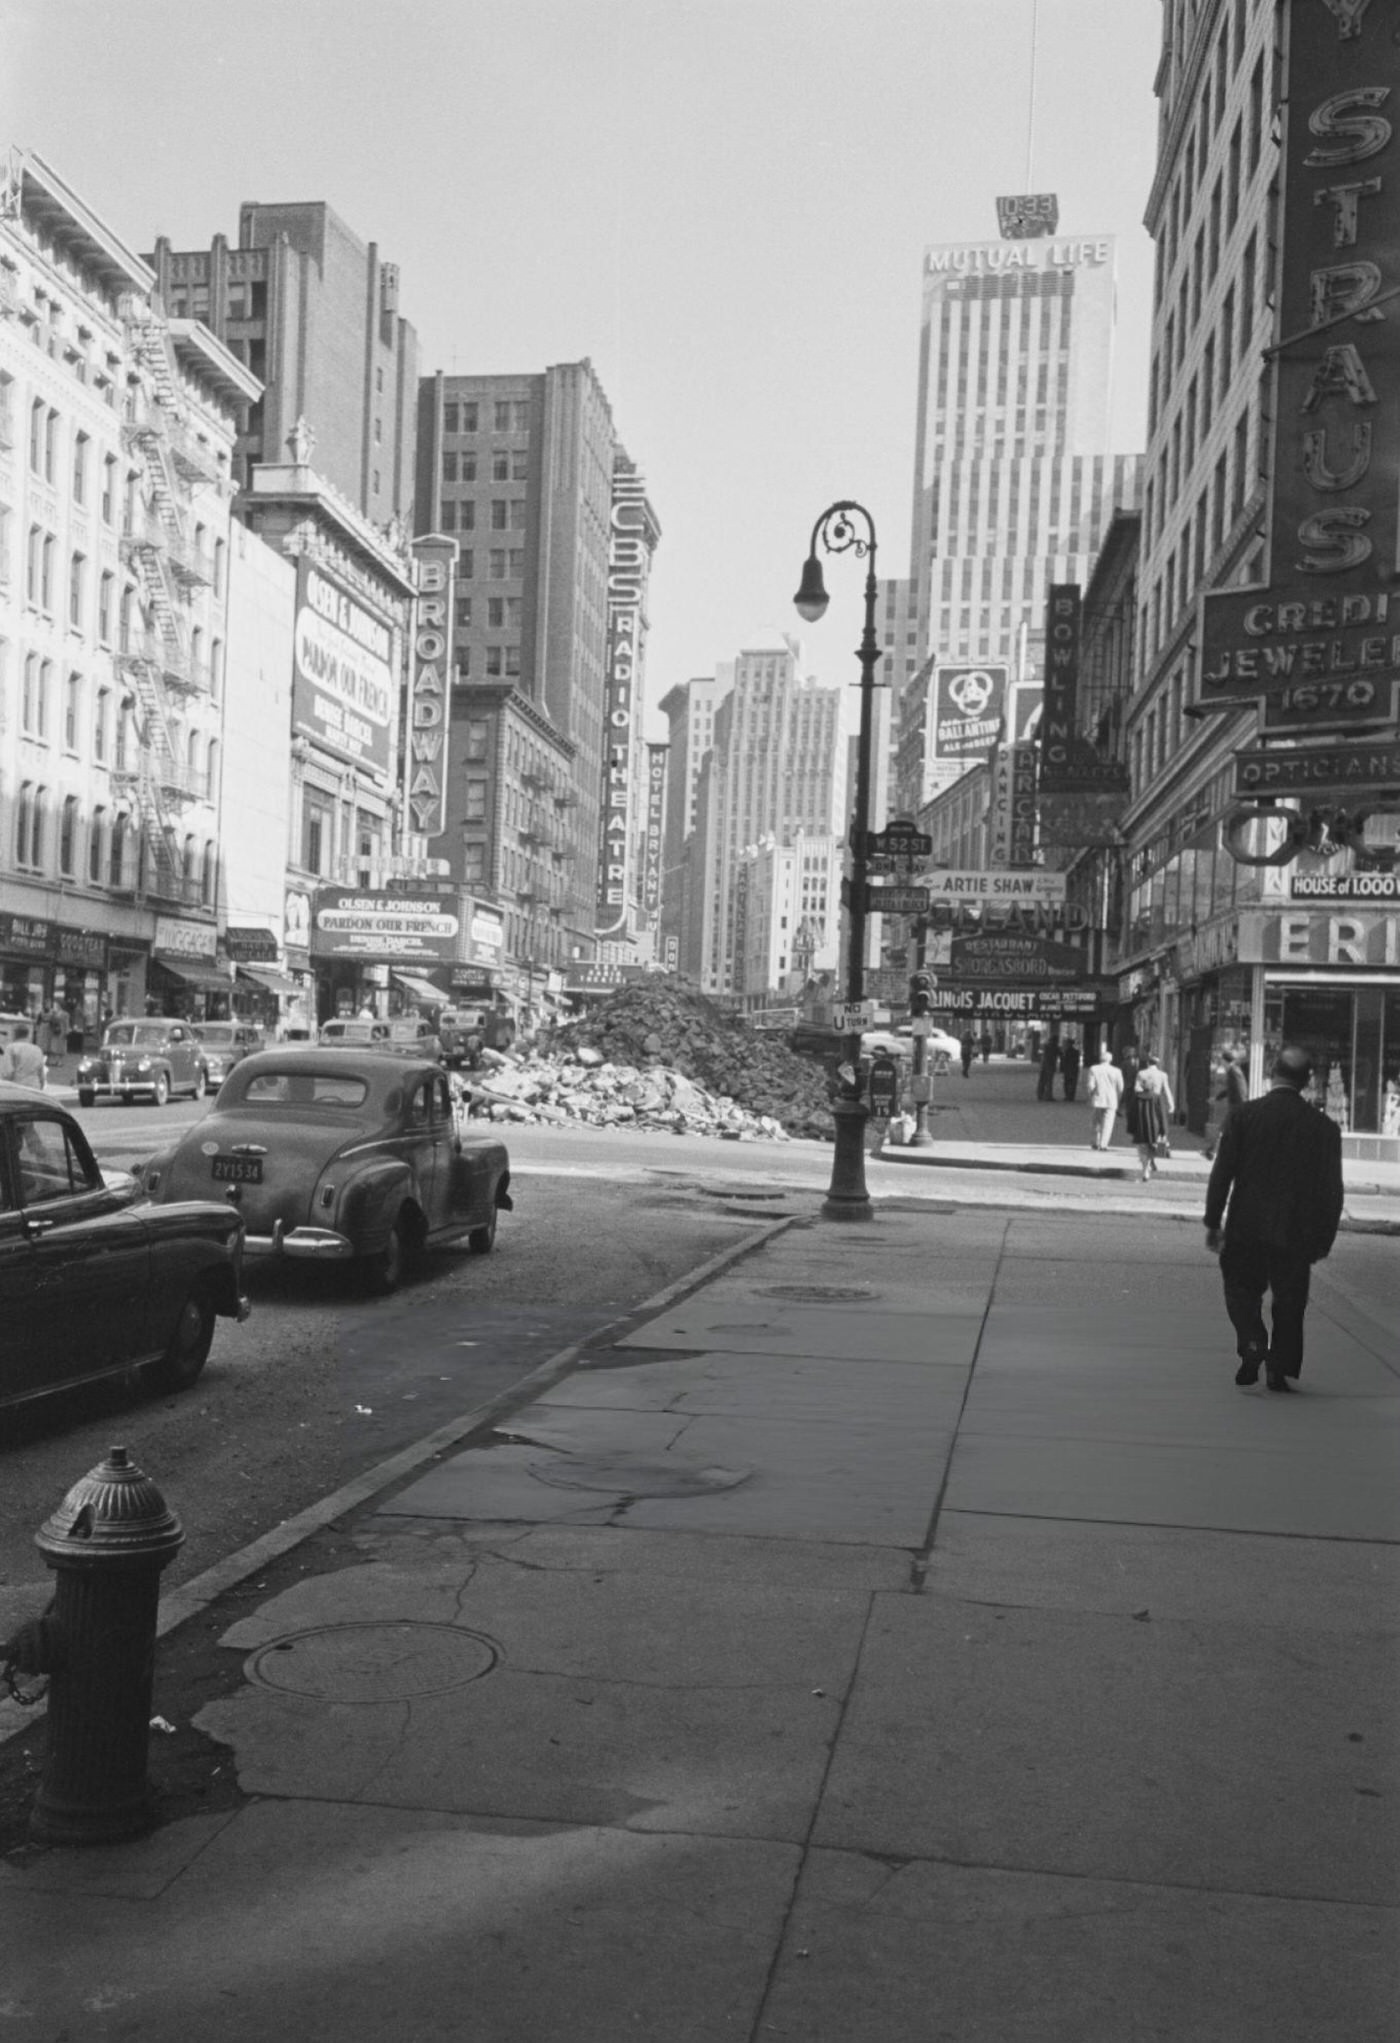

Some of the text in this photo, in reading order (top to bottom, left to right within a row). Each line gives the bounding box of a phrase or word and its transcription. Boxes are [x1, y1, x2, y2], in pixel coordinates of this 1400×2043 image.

[928, 243, 1108, 271] MUTUAL LIFE
[1296, 87, 1392, 573] STRAUS
[1243, 592, 1400, 636] CREDI
[410, 559, 446, 830] BROADWAY
[1050, 599, 1073, 763] BOWLING
[1281, 681, 1375, 708] 1670
[607, 500, 645, 904] CBS RADIO THEATRE
[650, 751, 664, 818] HOTEL
[995, 750, 1009, 860] DANCING
[889, 837, 908, 851] 52
[911, 838, 926, 851] ST
[647, 824, 660, 904] BRYANT
[943, 877, 988, 894] ARTIE
[993, 877, 1035, 894] SHAW
[1294, 877, 1337, 894] HOUSE
[1338, 877, 1350, 894] of
[338, 898, 375, 911] OLSEN
[386, 901, 441, 913] JOHNSON
[322, 916, 373, 930] PARDON
[375, 919, 403, 931] OUR
[844, 1004, 861, 1014] NO
[977, 992, 1036, 1009] JACQUET
[834, 1016, 868, 1030] U TURN
